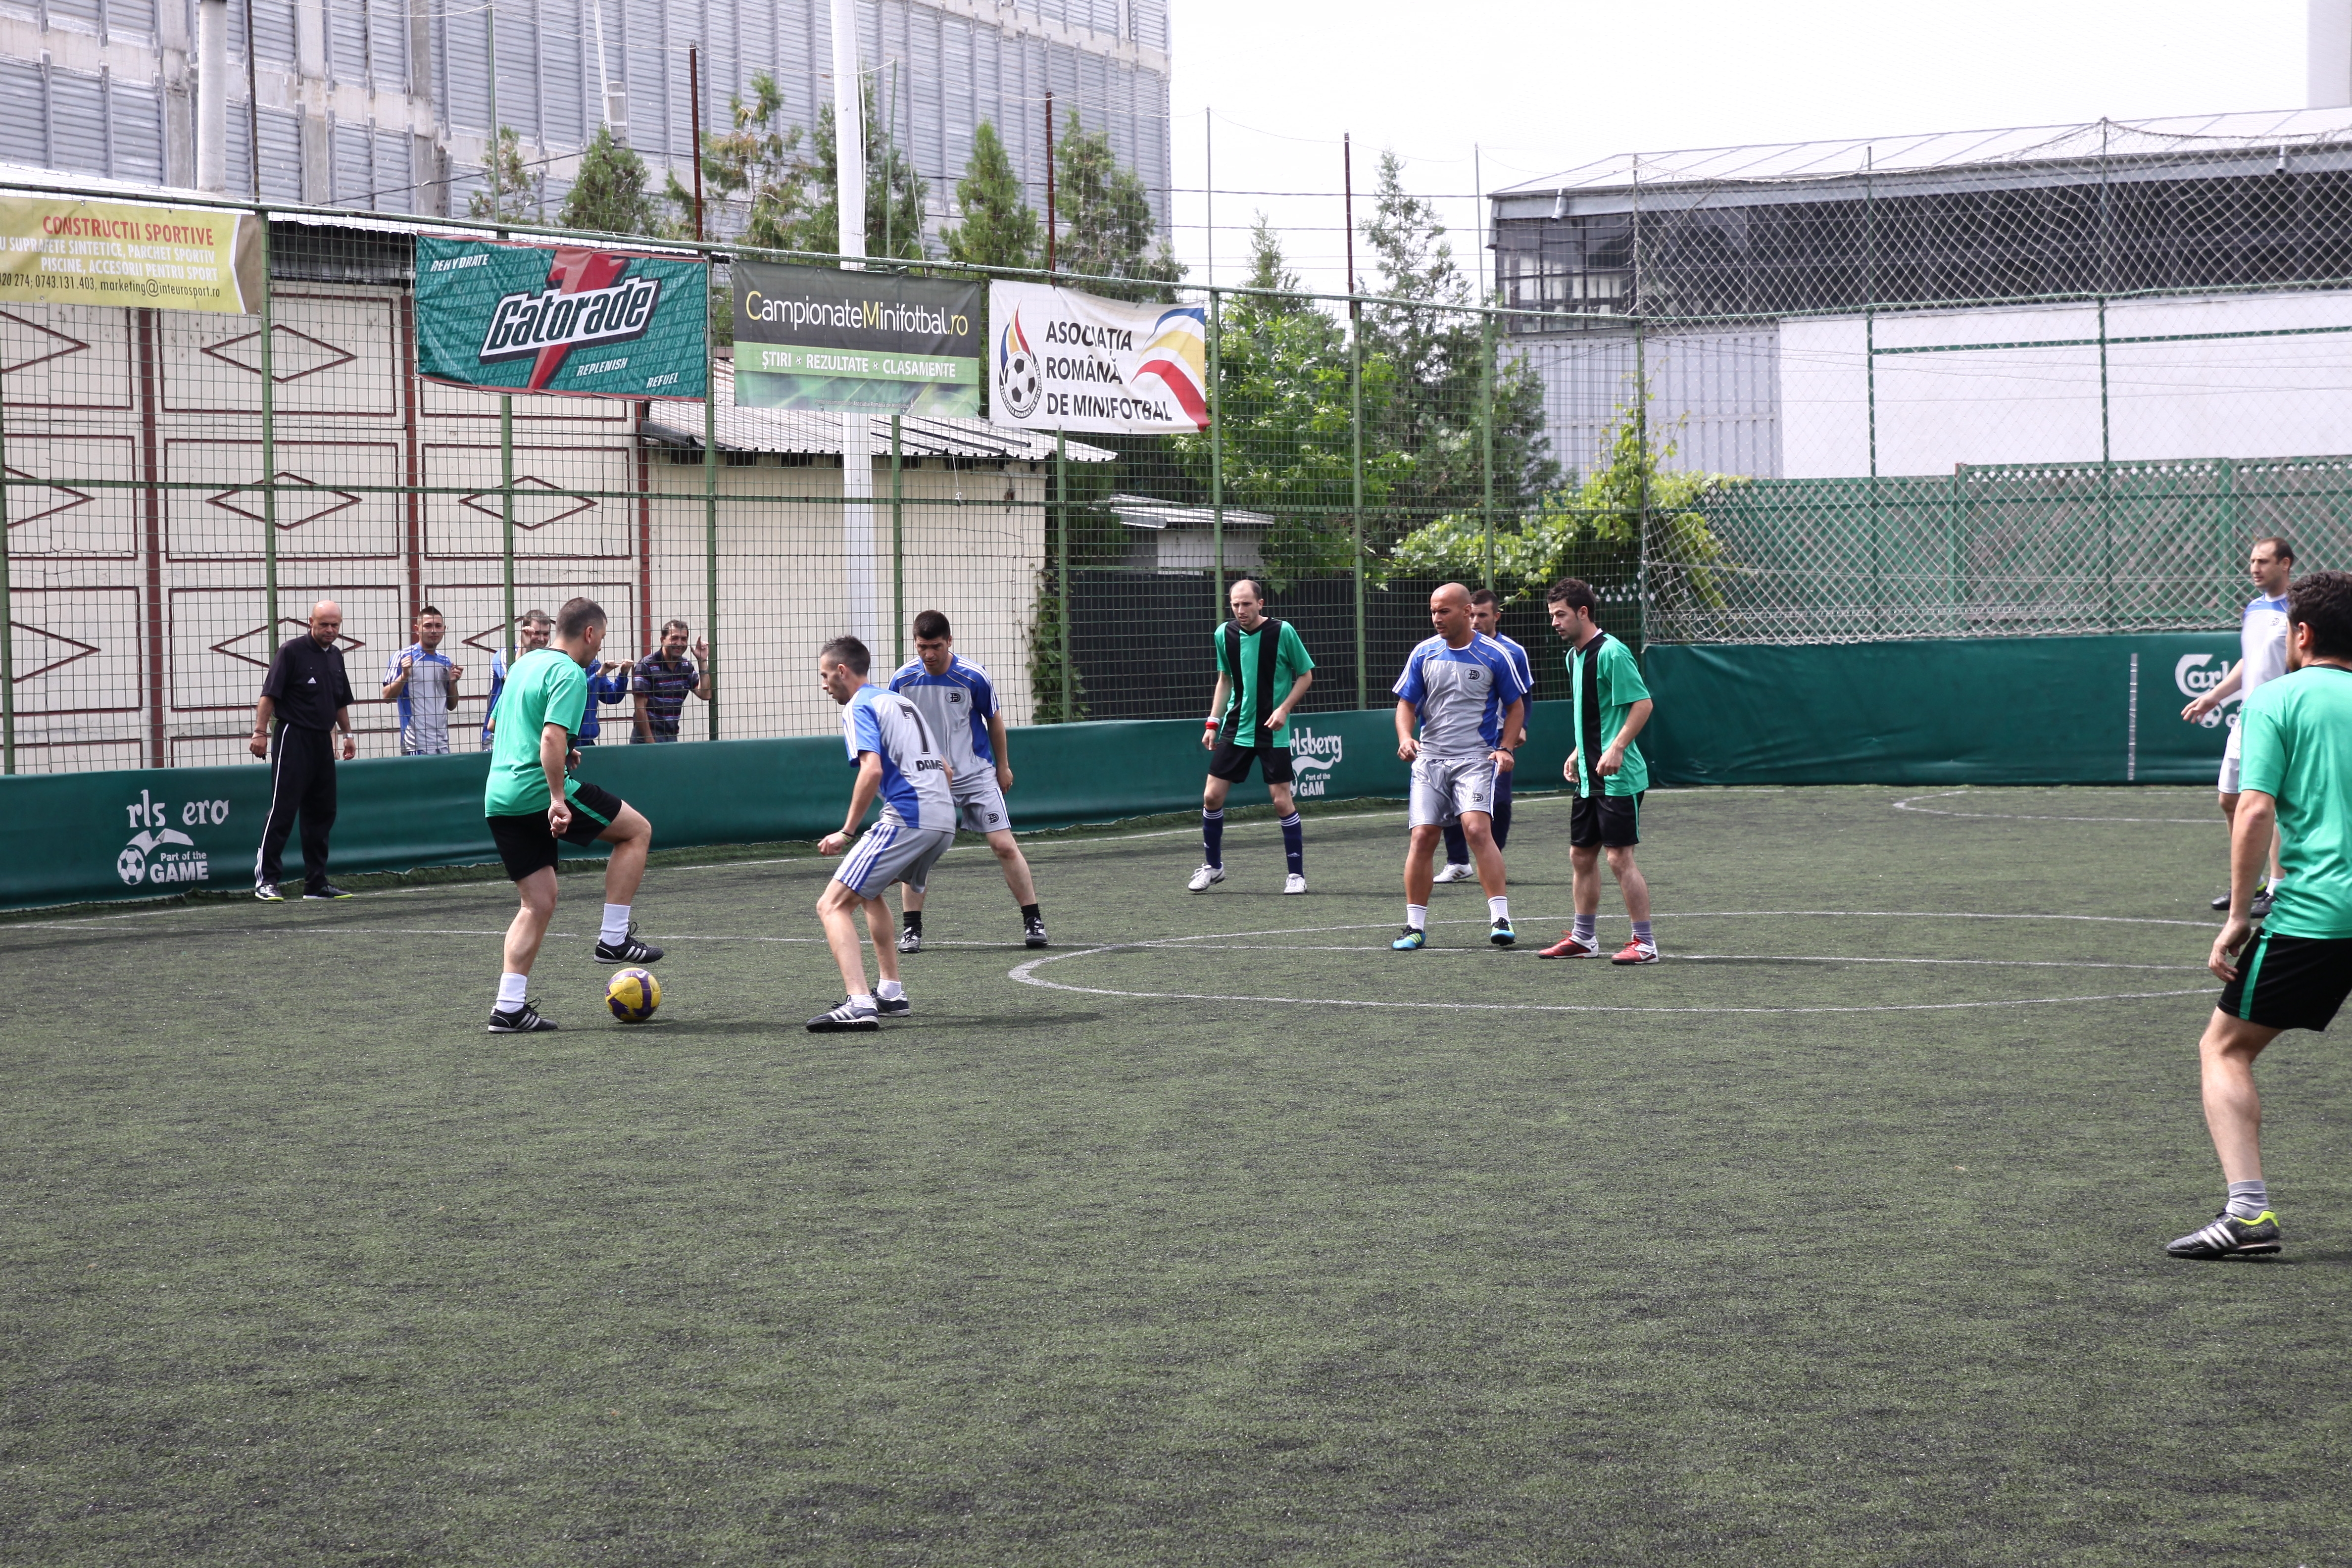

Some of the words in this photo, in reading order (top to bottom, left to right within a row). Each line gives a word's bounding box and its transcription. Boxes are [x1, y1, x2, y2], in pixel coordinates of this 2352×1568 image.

[43, 216, 141, 240] CONSTRUCTII
[145, 223, 214, 246] SPORTIVE
[9, 237, 66, 254] SUPRAFETE
[69, 240, 125, 260] SINTETICE,
[128, 244, 171, 261] PARCHET
[174, 247, 215, 264] SPORTIV
[430, 254, 490, 272] REHYDRATE
[41, 257, 86, 275] PISCINE,
[89, 259, 143, 277] ACCESORII
[146, 263, 185, 279] PENTRU
[187, 266, 218, 282] SPORT
[0, 273, 11, 286] 20
[14, 274, 33, 289] 274;
[100, 279, 220, 299] marketing@inteurosport.ro
[485, 282, 654, 351] Gatorade
[745, 291, 969, 336] CampionateMinifotbal.ro
[577, 357, 628, 377] REPLENISH
[806, 353, 869, 373] REZULTATE
[883, 359, 955, 378] CLASAMENTE
[1046, 354, 1123, 385] ROMÂNĂ
[646, 372, 679, 389] REFUEL
[1047, 392, 1069, 415] DE
[1074, 394, 1173, 421] MINIFOTBAL
[895, 700, 931, 755] 7
[1290, 727, 1342, 763] rlsberg
[160, 852, 179, 862] Part
[182, 851, 190, 861] of
[193, 850, 206, 860] the
[150, 861, 209, 883] GAME
